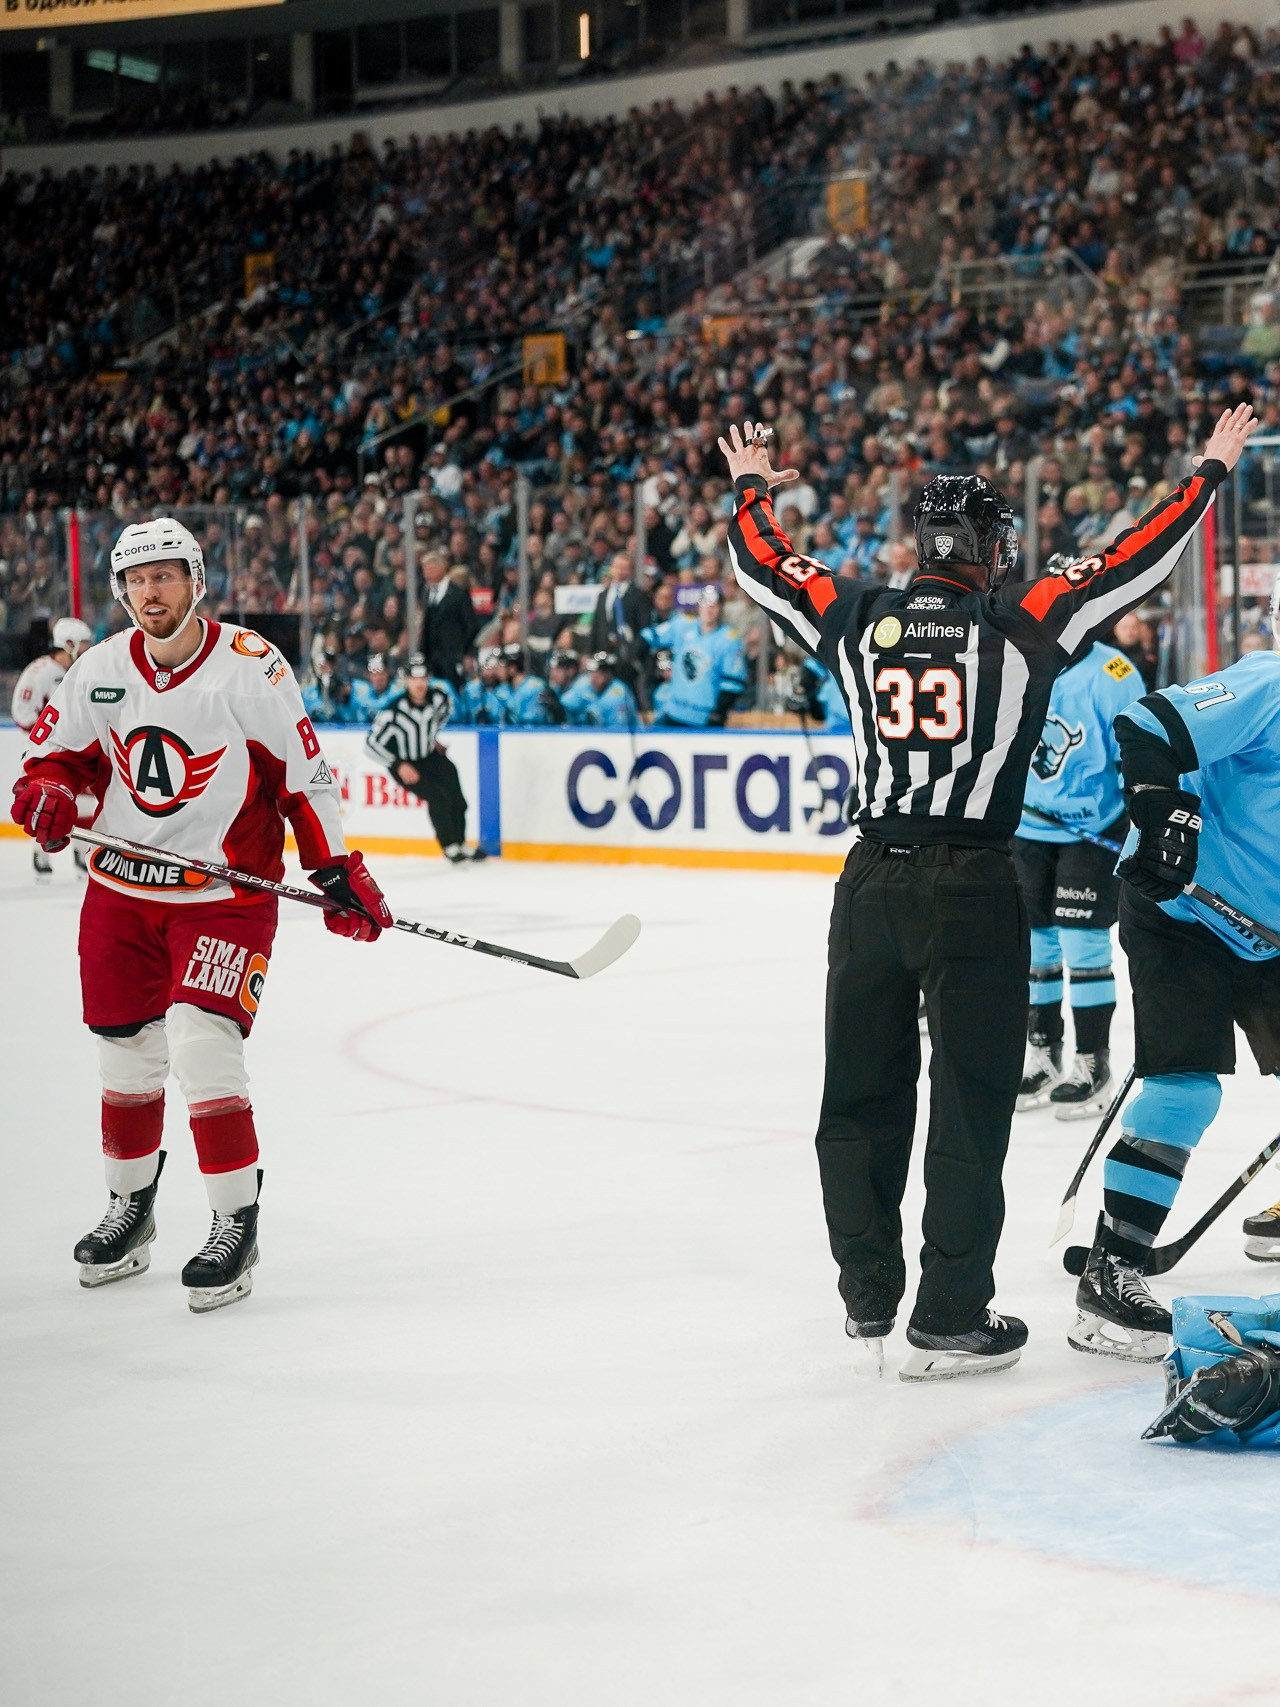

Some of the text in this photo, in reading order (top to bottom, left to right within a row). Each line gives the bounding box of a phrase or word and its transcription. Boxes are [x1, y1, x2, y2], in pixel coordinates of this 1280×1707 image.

[913, 596, 944, 604] SEASON
[903, 622, 965, 638] Airlines
[95, 690, 118, 700] МИР
[875, 667, 963, 740] 33
[1183, 682, 1237, 711] 61
[98, 850, 181, 884] WINLINE
[196, 861, 304, 896] JETSPEED
[322, 874, 341, 887] CCM
[1056, 886, 1097, 901] Belavia
[1054, 906, 1093, 919] CCM
[1211, 897, 1254, 928] TRUE
[393, 915, 478, 949] CCM
[192, 935, 249, 974] SIMA
[182, 959, 241, 999] LAND
